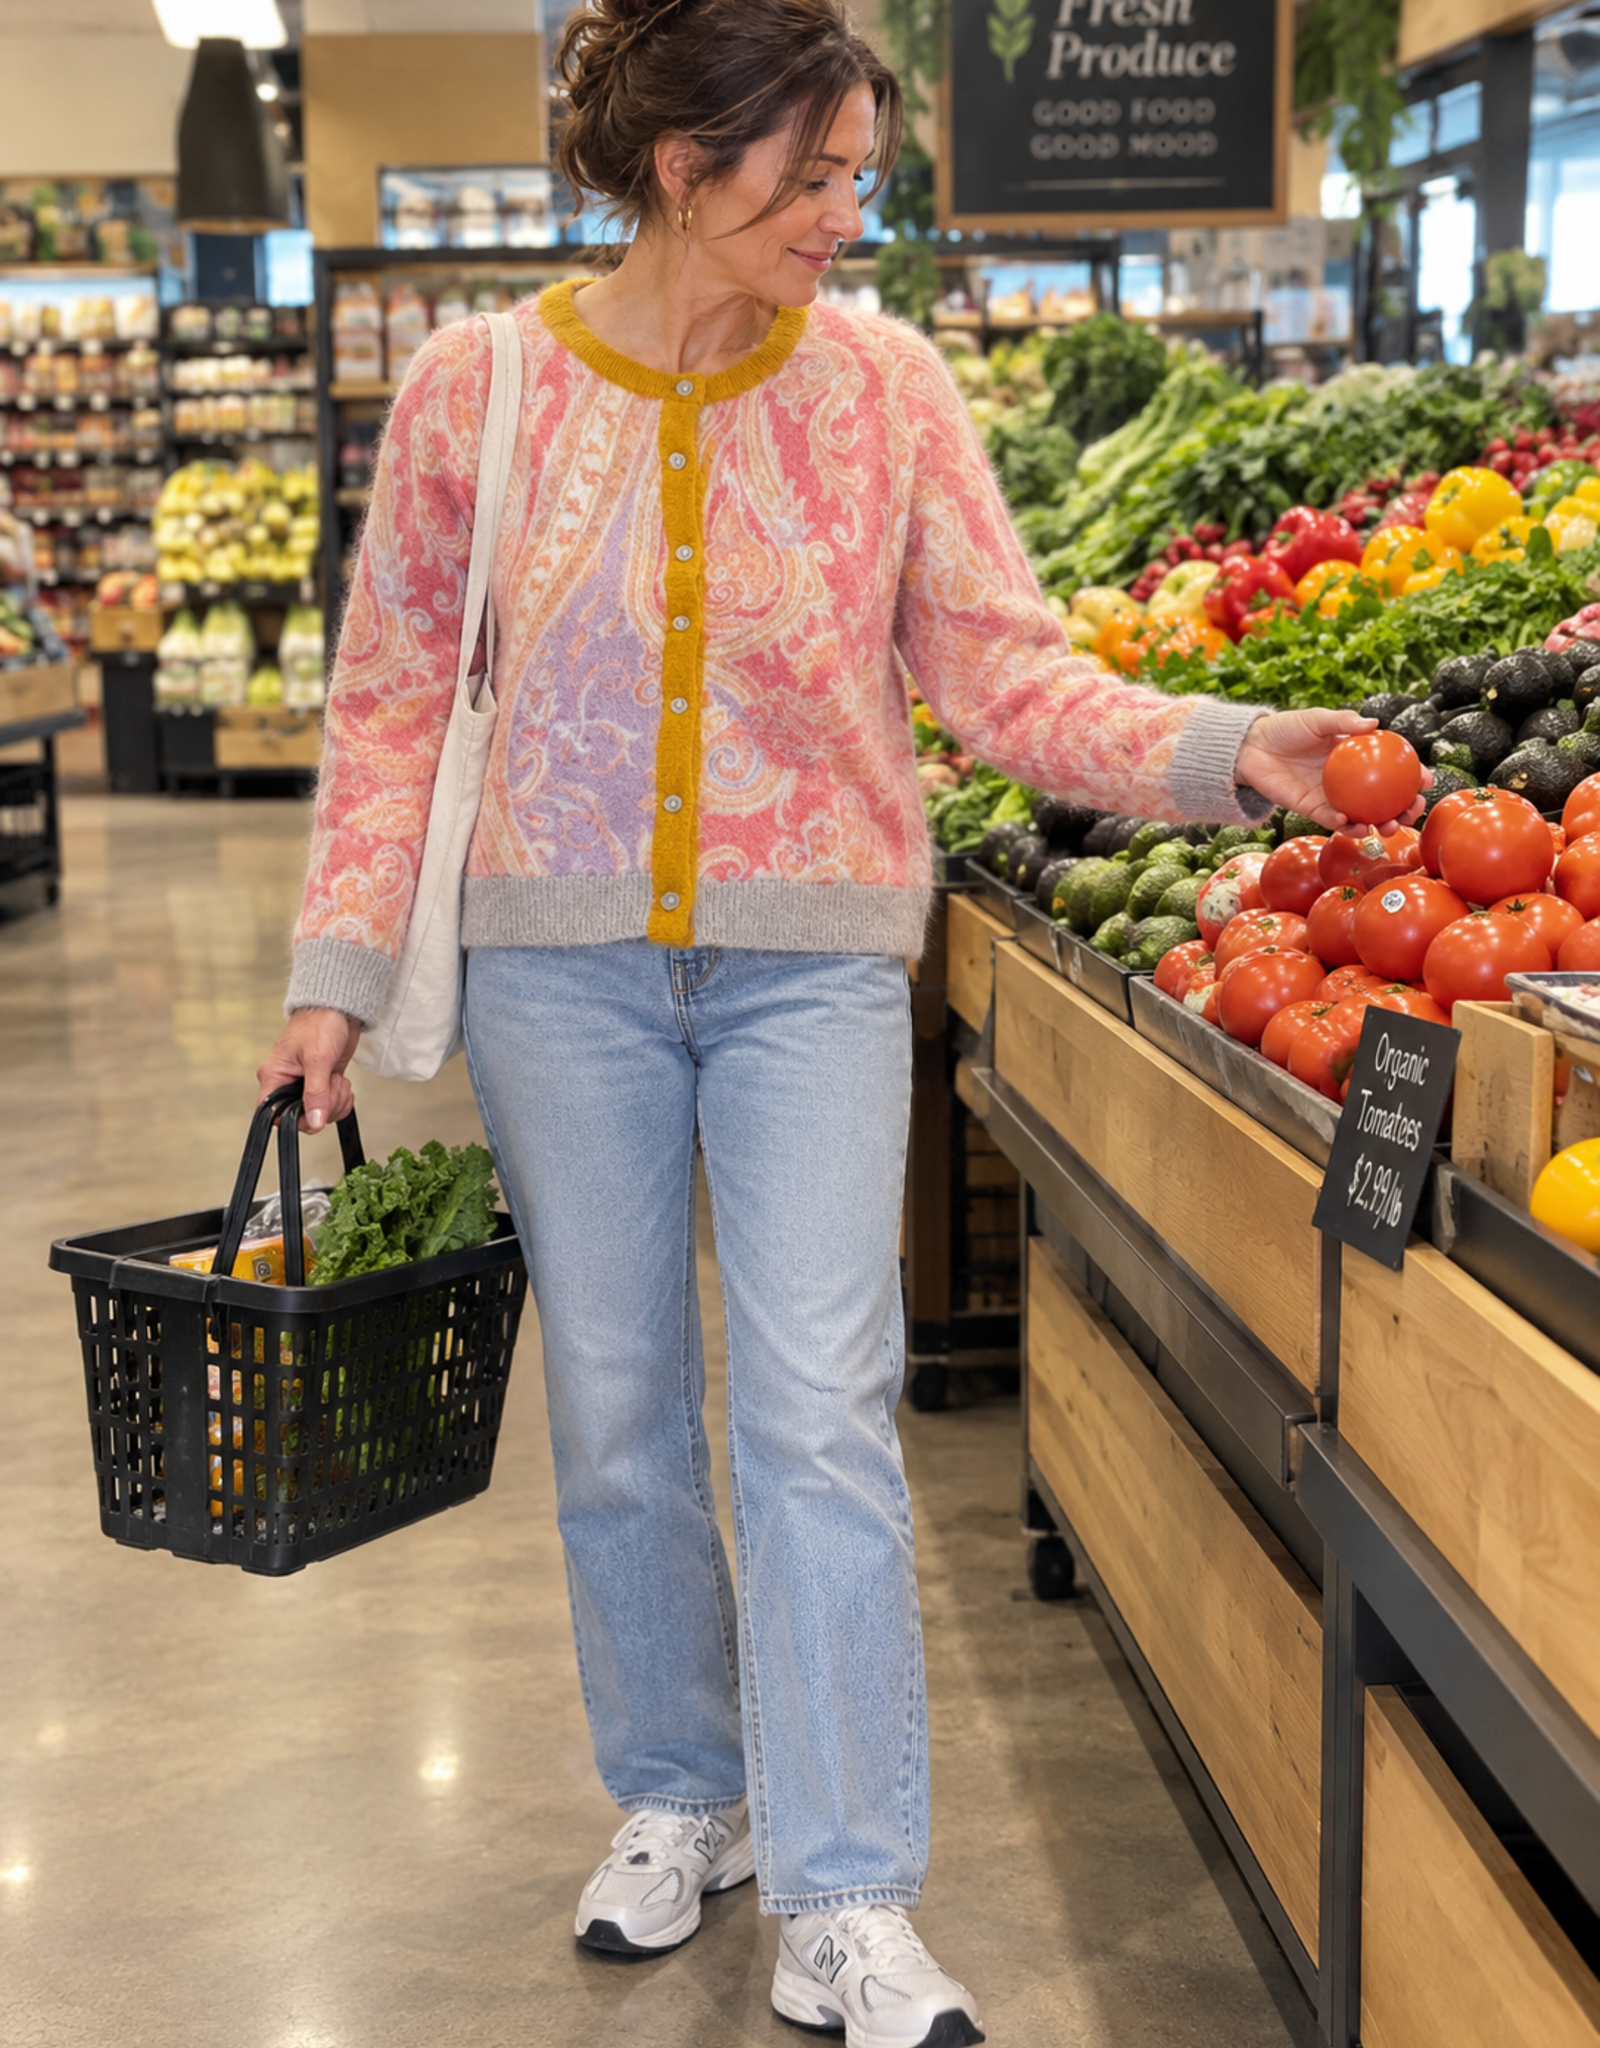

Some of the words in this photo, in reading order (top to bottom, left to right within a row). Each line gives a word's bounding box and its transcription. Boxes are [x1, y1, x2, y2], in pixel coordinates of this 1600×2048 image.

[1047, 29, 1237, 79] Produce
[1032, 99, 1122, 127] GOOD
[1130, 97, 1216, 125] FOOD
[1029, 132, 1120, 160] GOOD
[1128, 131, 1218, 158] MOOD
[1374, 1032, 1429, 1091] Organic
[814, 1935, 848, 1984] N
